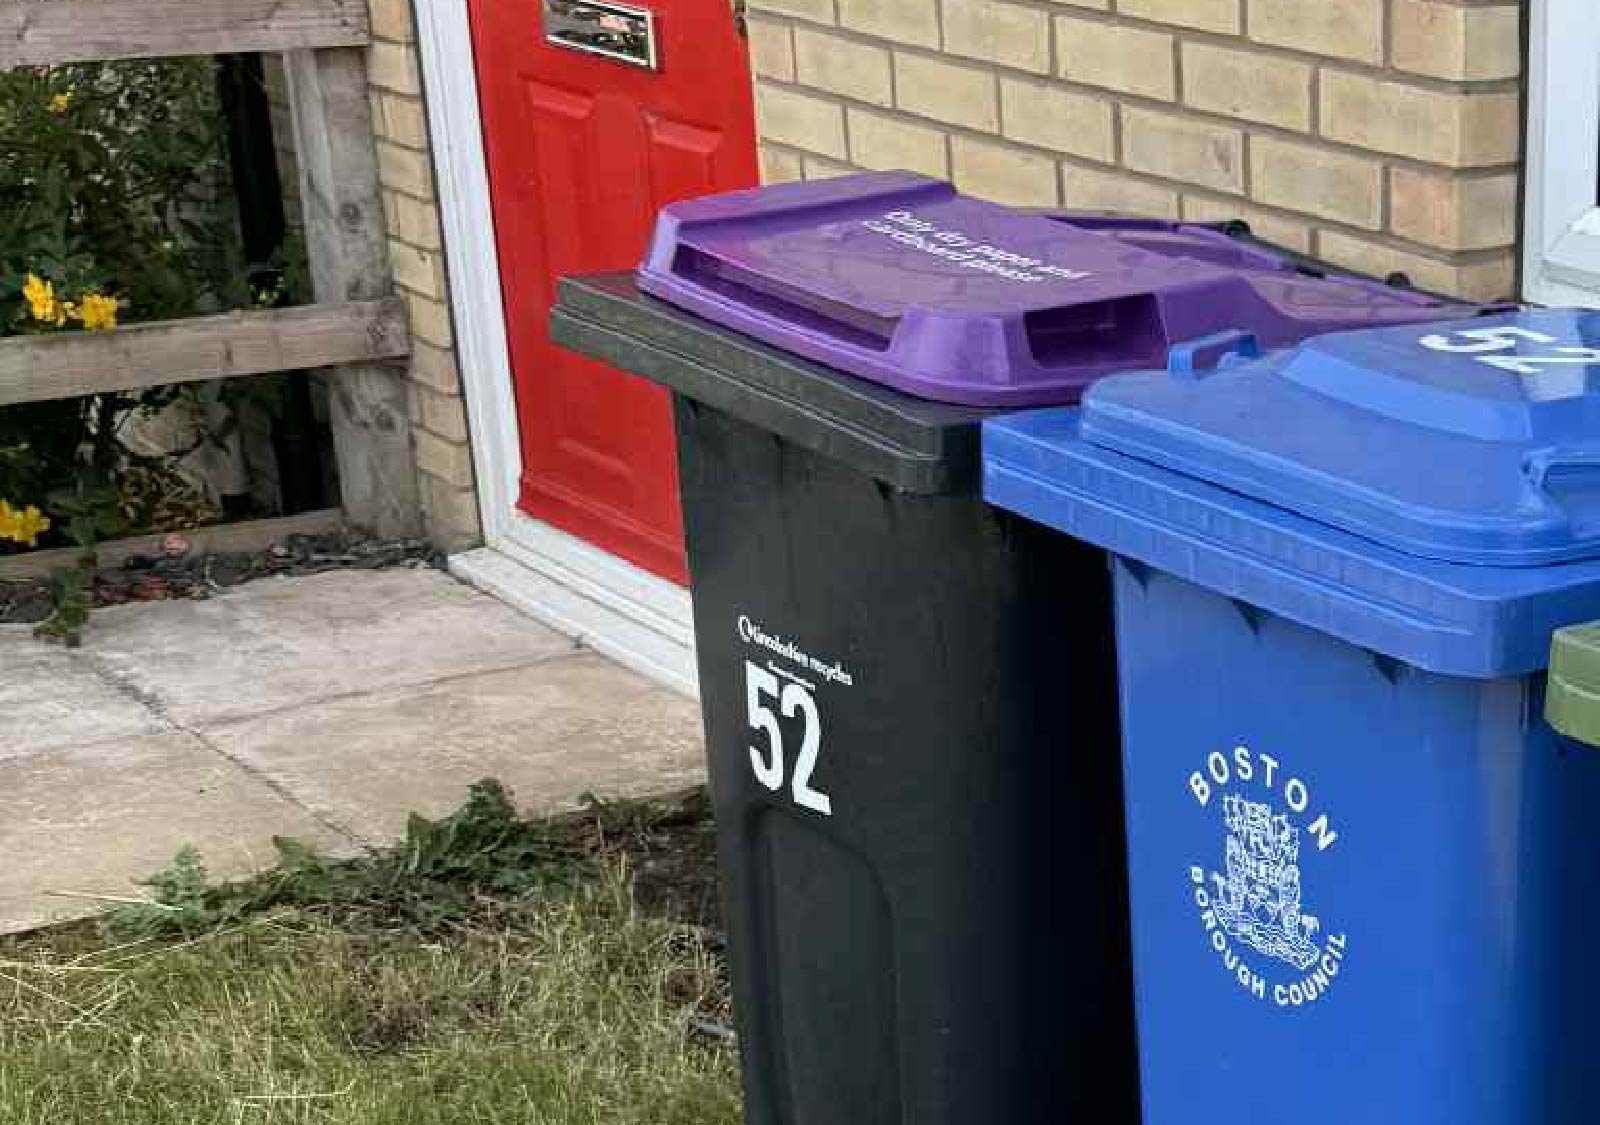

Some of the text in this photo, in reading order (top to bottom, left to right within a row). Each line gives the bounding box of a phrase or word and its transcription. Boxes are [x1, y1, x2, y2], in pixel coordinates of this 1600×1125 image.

[745, 660, 831, 815] 52
[1189, 745, 1338, 852] BOSTON
[1190, 865, 1347, 1007] BOROUGH COUNCIL
